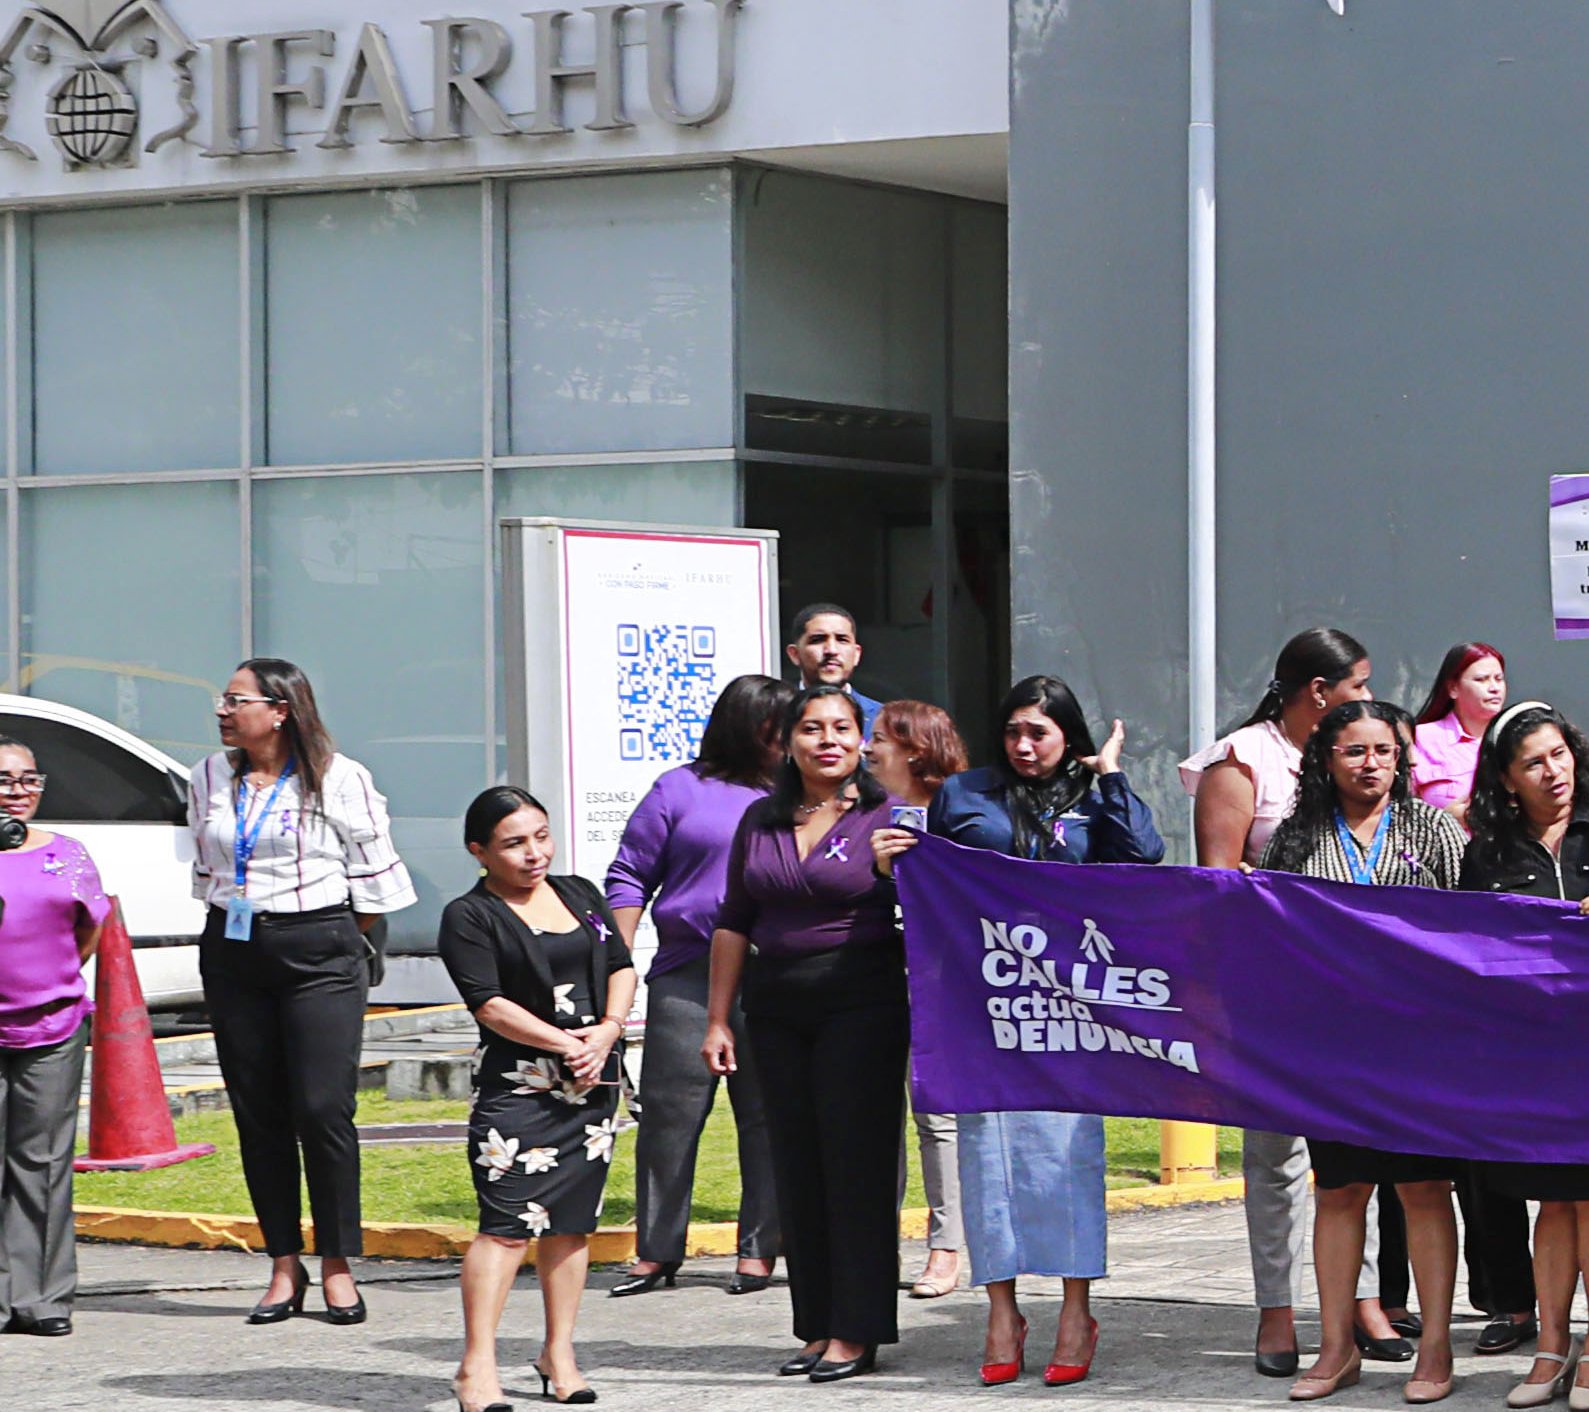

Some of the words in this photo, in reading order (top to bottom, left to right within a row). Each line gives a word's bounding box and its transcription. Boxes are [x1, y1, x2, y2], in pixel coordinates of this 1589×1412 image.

[585, 791, 636, 804] ESCANEA
[587, 830, 606, 842] DEL
[980, 918, 1048, 958] NO
[982, 949, 1171, 1007] CALLES
[987, 989, 1093, 1022] actúa
[991, 1019, 1200, 1073] DENUNCIA
